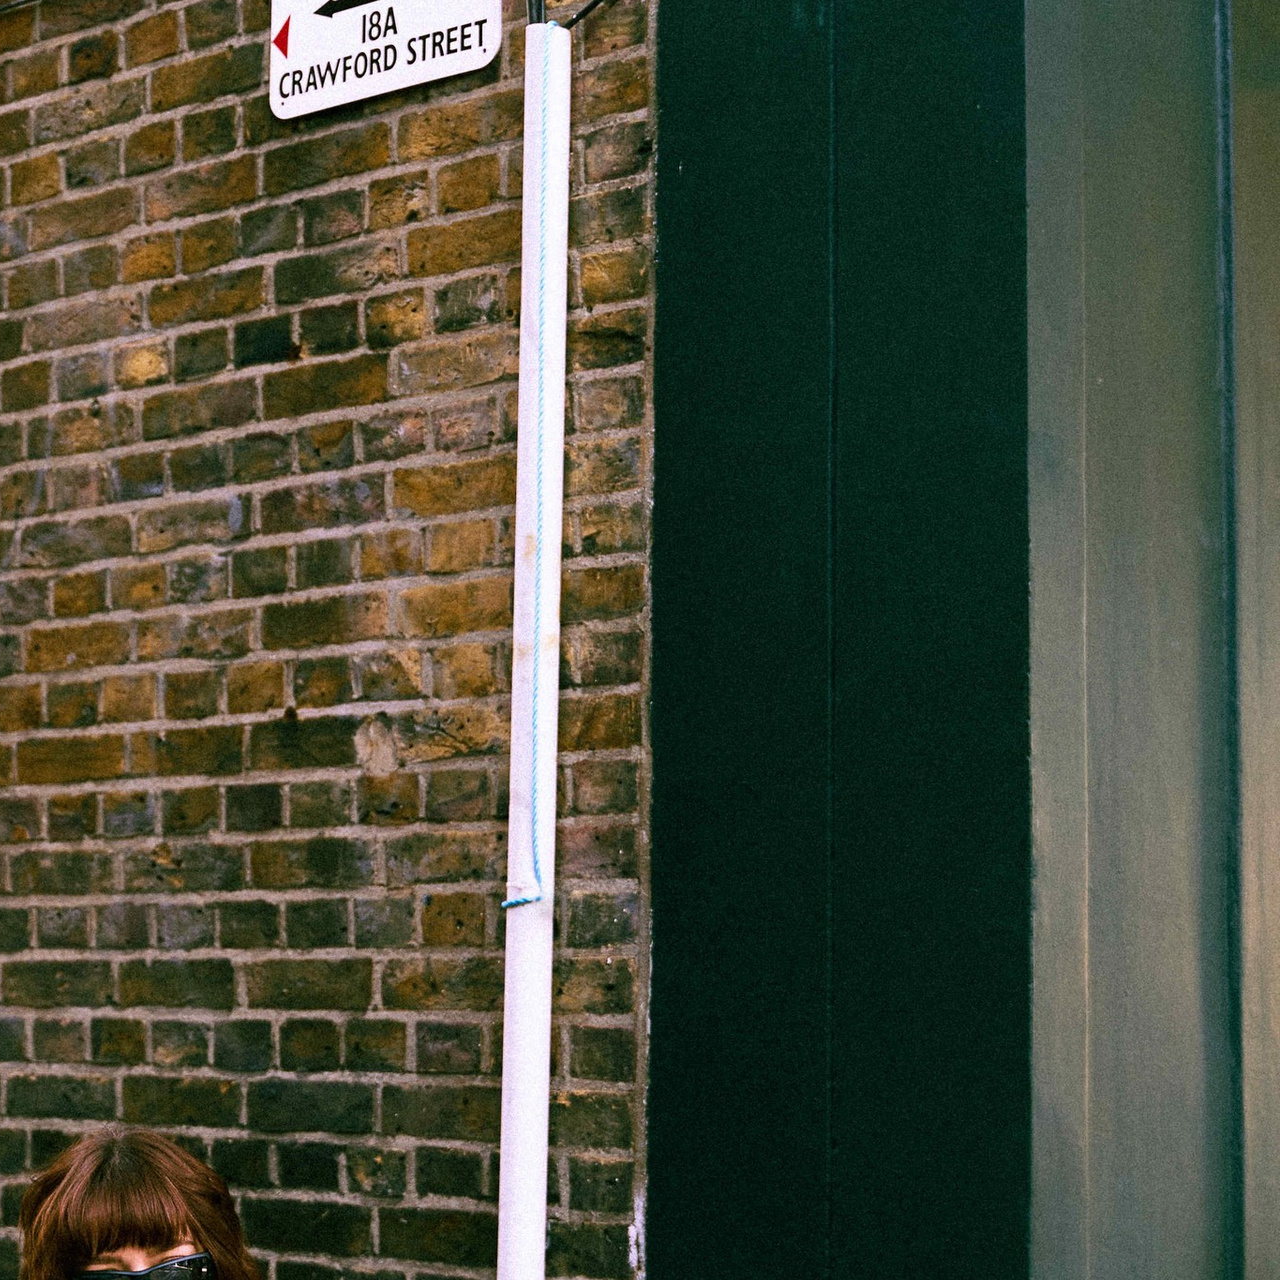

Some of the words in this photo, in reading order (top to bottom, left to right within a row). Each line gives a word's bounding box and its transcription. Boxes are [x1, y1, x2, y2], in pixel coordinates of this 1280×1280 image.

[361, 7, 397, 43] 18A
[280, 45, 397, 98] CRAWFORD
[407, 19, 487, 65] STREET
